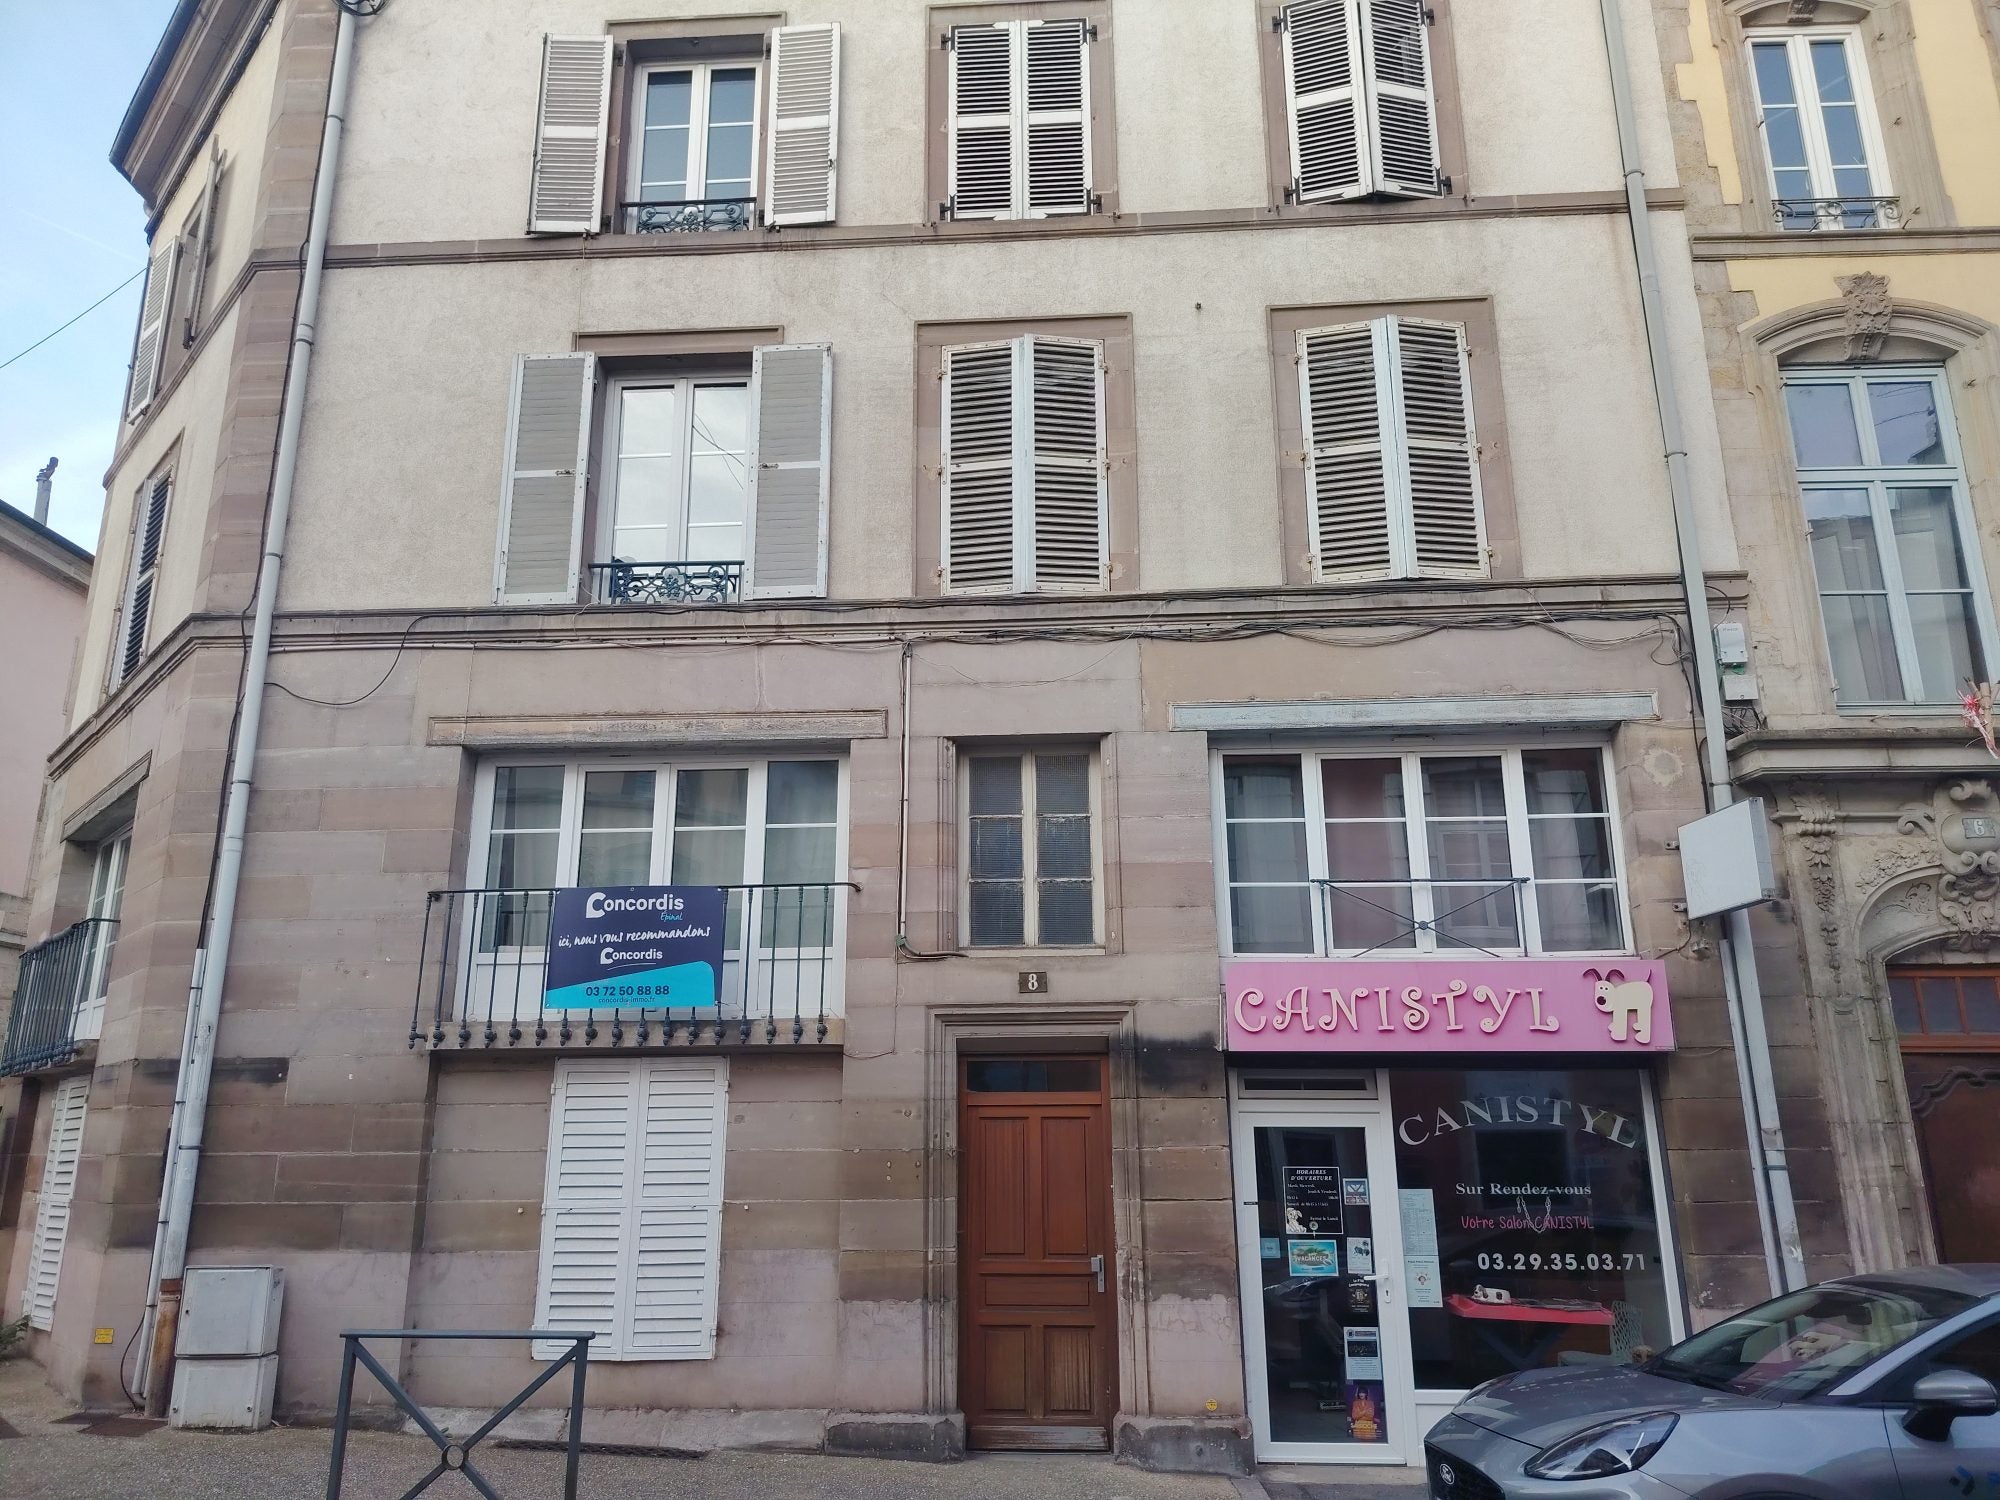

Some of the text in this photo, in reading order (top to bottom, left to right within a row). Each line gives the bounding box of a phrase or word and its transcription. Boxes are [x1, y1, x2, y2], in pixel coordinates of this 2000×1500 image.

[1974, 819, 1984, 836] 6
[585, 892, 684, 918] Concordis
[558, 924, 711, 948] ici, nous vous recommandons
[600, 947, 663, 964] Concordis
[586, 985, 670, 996] 03 72 50 88 88
[1028, 973, 1039, 991] 8
[1233, 979, 1560, 1034] CANISTYL
[1398, 1095, 1639, 1149] CANISTYL
[1455, 1182, 1592, 1195] Sur Rendez-vous
[1461, 1215, 1594, 1229] Votre Salon CANISTYL
[1477, 1252, 1646, 1271] 03.29.35.03.71
